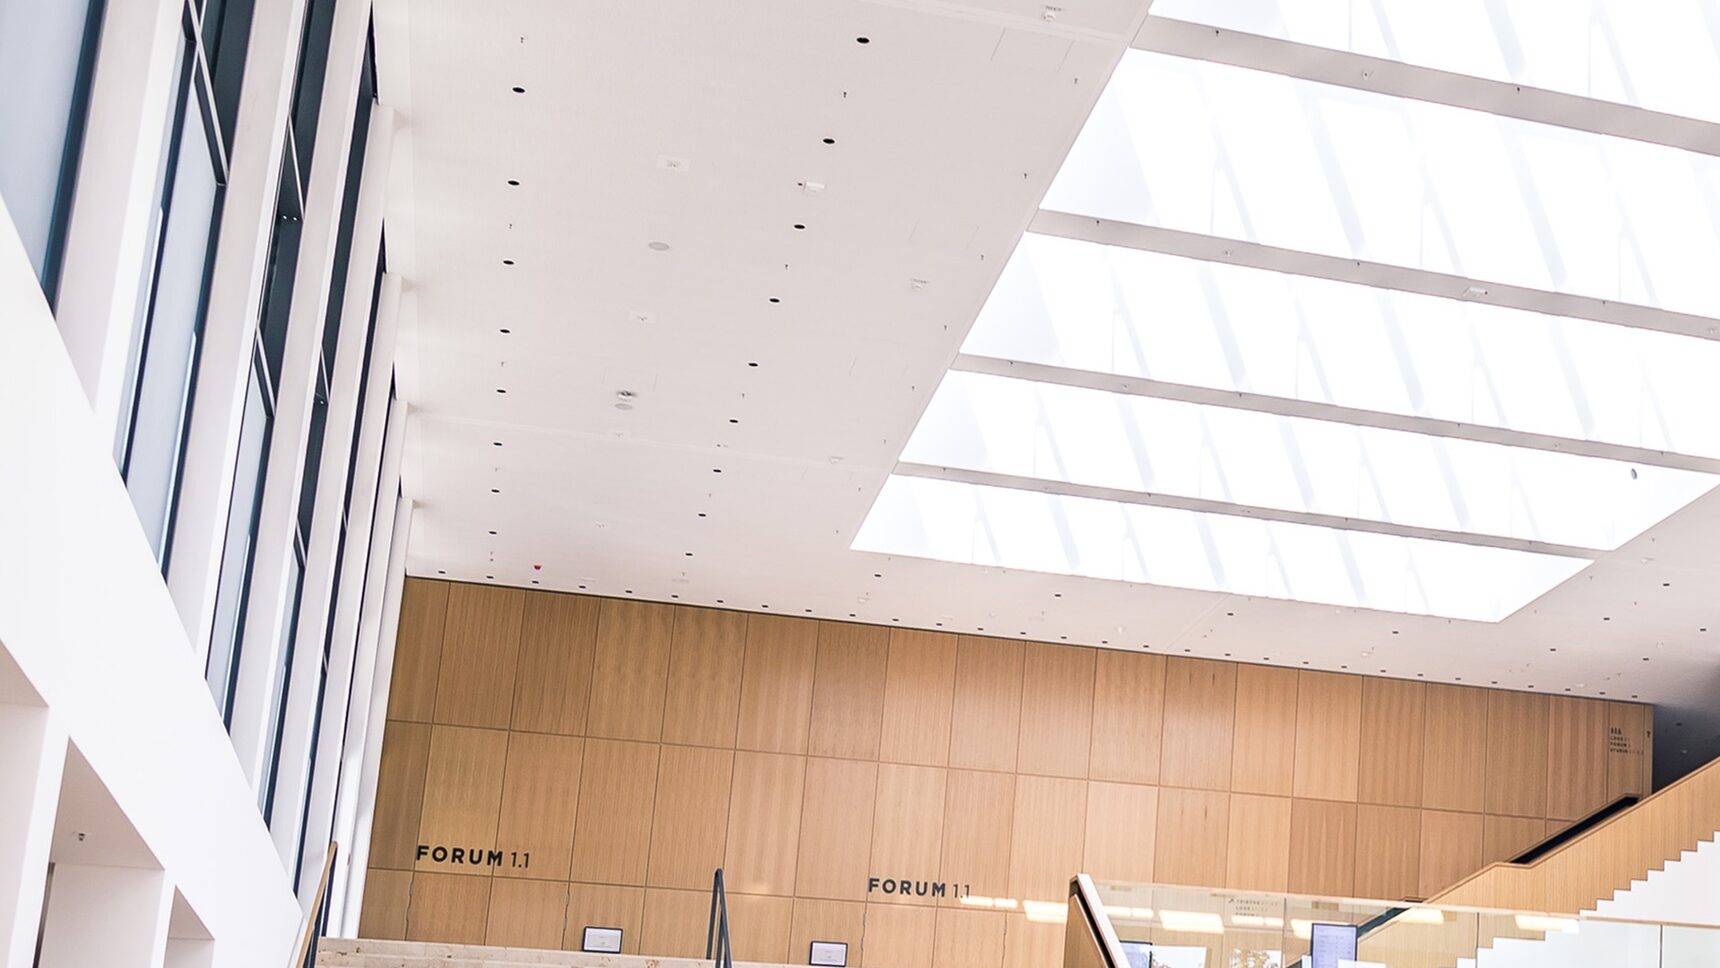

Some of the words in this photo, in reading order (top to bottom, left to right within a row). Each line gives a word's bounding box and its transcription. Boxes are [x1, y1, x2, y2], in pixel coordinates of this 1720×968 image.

[416, 845, 503, 867] FORUM
[511, 852, 529, 868] 1.1
[868, 878, 946, 897] FORUM
[953, 884, 970, 898] 1.1
